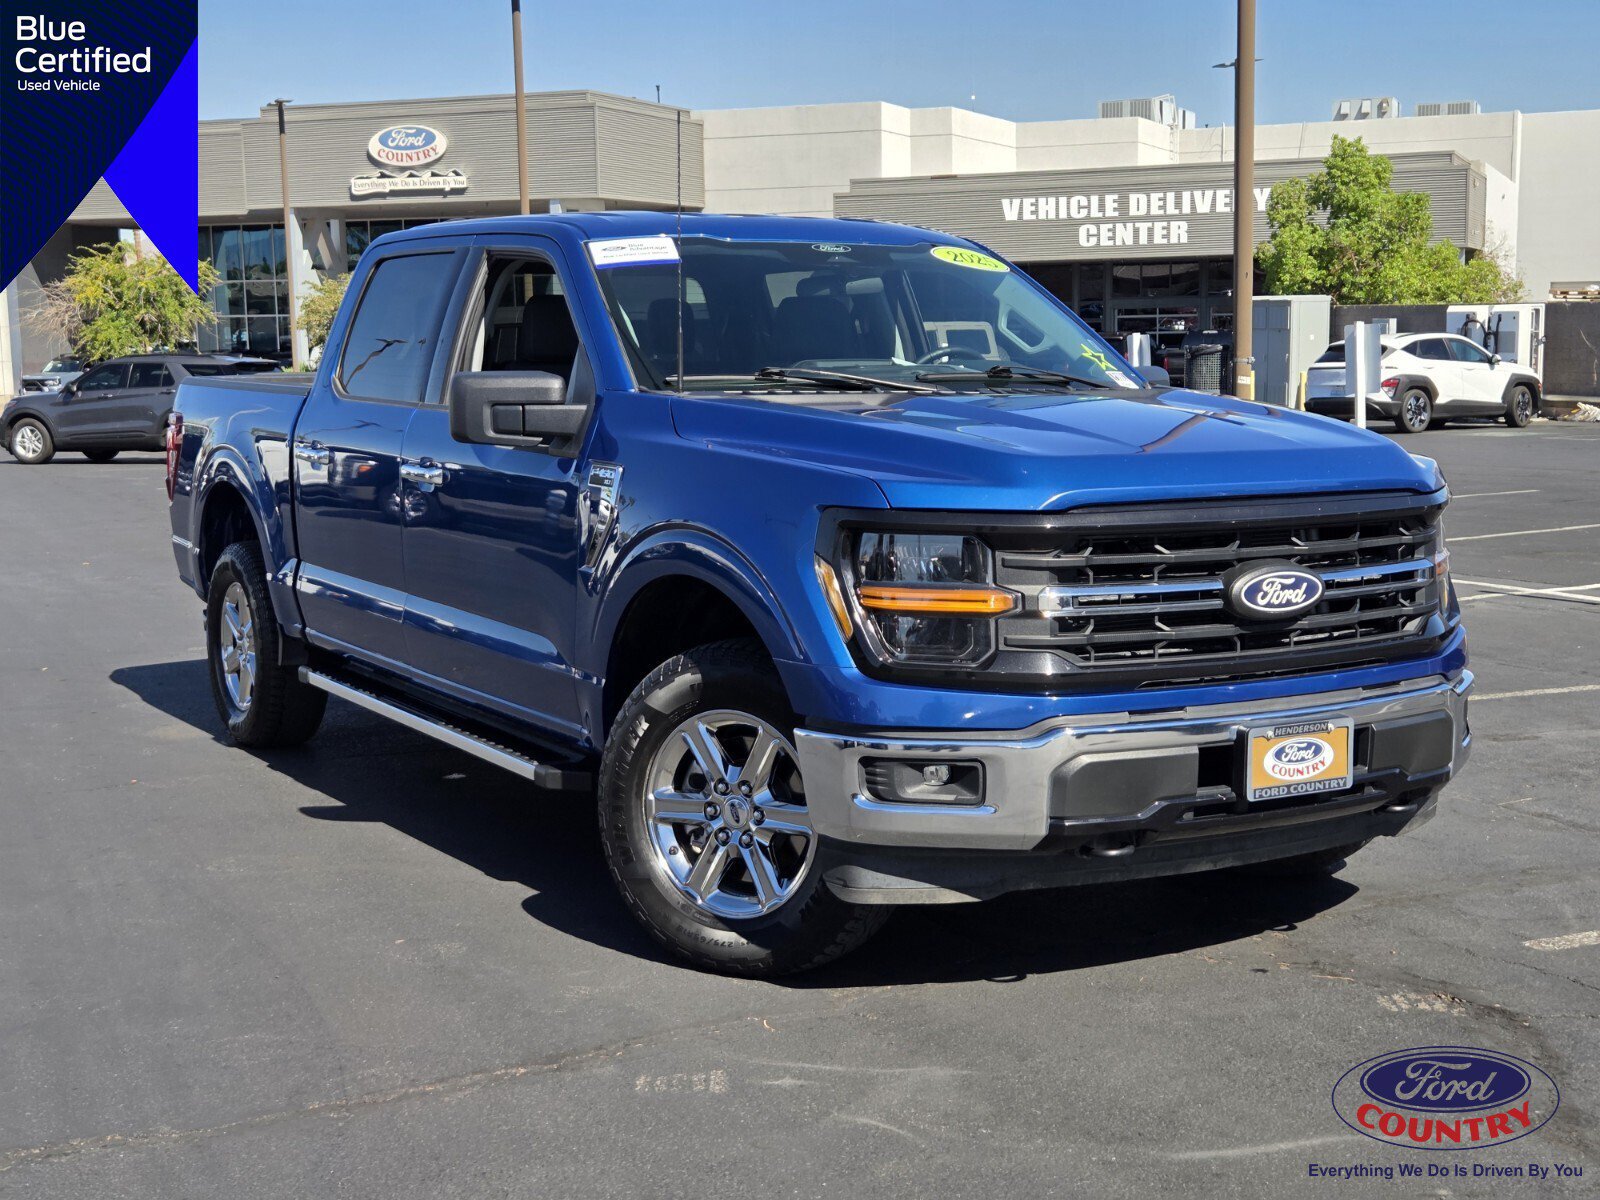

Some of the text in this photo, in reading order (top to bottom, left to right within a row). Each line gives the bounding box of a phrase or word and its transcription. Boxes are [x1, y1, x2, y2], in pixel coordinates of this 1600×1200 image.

[388, 128, 426, 147] Ford
[377, 145, 440, 163] COUNTRY
[353, 180, 387, 189] Everything
[412, 179, 418, 187] Is
[442, 179, 451, 187] By
[453, 178, 465, 186] You
[1001, 187, 1272, 221] VEHICLE DELIVEY
[1078, 220, 1189, 247] CENTER
[946, 250, 999, 268] 2025
[1257, 577, 1308, 606] Ford
[1275, 722, 1328, 736] HENDERSON
[1281, 742, 1316, 762] Ford
[1271, 757, 1327, 778] COUNTRY
[1255, 778, 1346, 799] FORD COUNTRY
